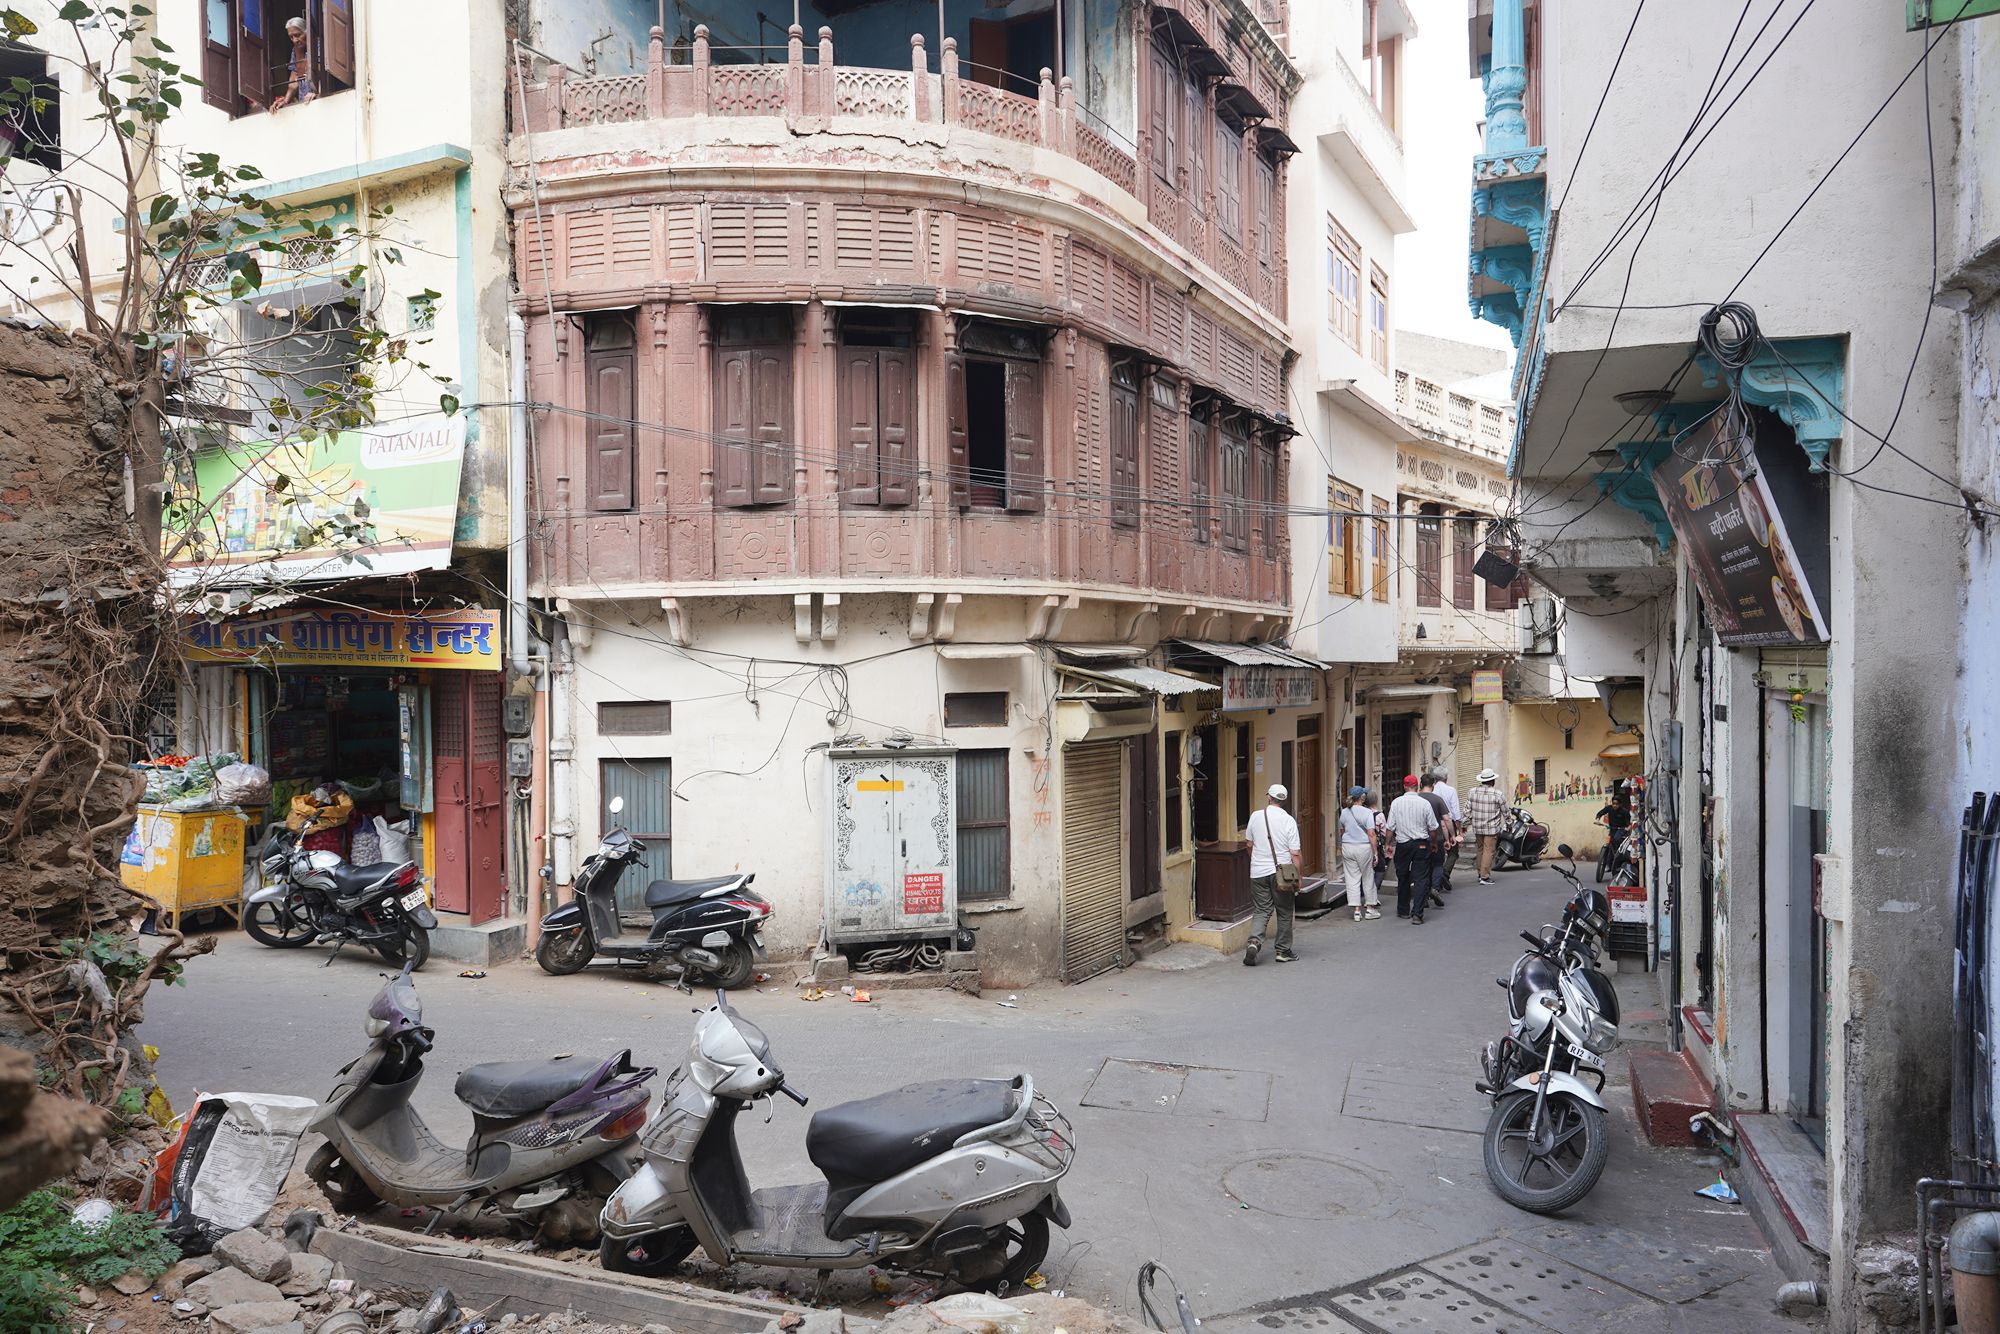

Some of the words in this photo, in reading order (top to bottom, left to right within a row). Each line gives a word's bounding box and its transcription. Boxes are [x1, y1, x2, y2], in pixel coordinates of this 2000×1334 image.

[368, 428, 451, 455] PATANJALI
[272, 565, 310, 578] SHOPPING
[312, 563, 343, 574] CENTER
[404, 611, 494, 655] सेन्टर
[907, 875, 940, 883] DANGER
[906, 896, 941, 905] खतरा
[222, 1119, 241, 1133] DECO
[240, 1128, 260, 1137] SHINE
[543, 1128, 576, 1142] Scooty
[184, 1145, 196, 1159] TILE
[176, 1158, 191, 1189] ADHESIVE
